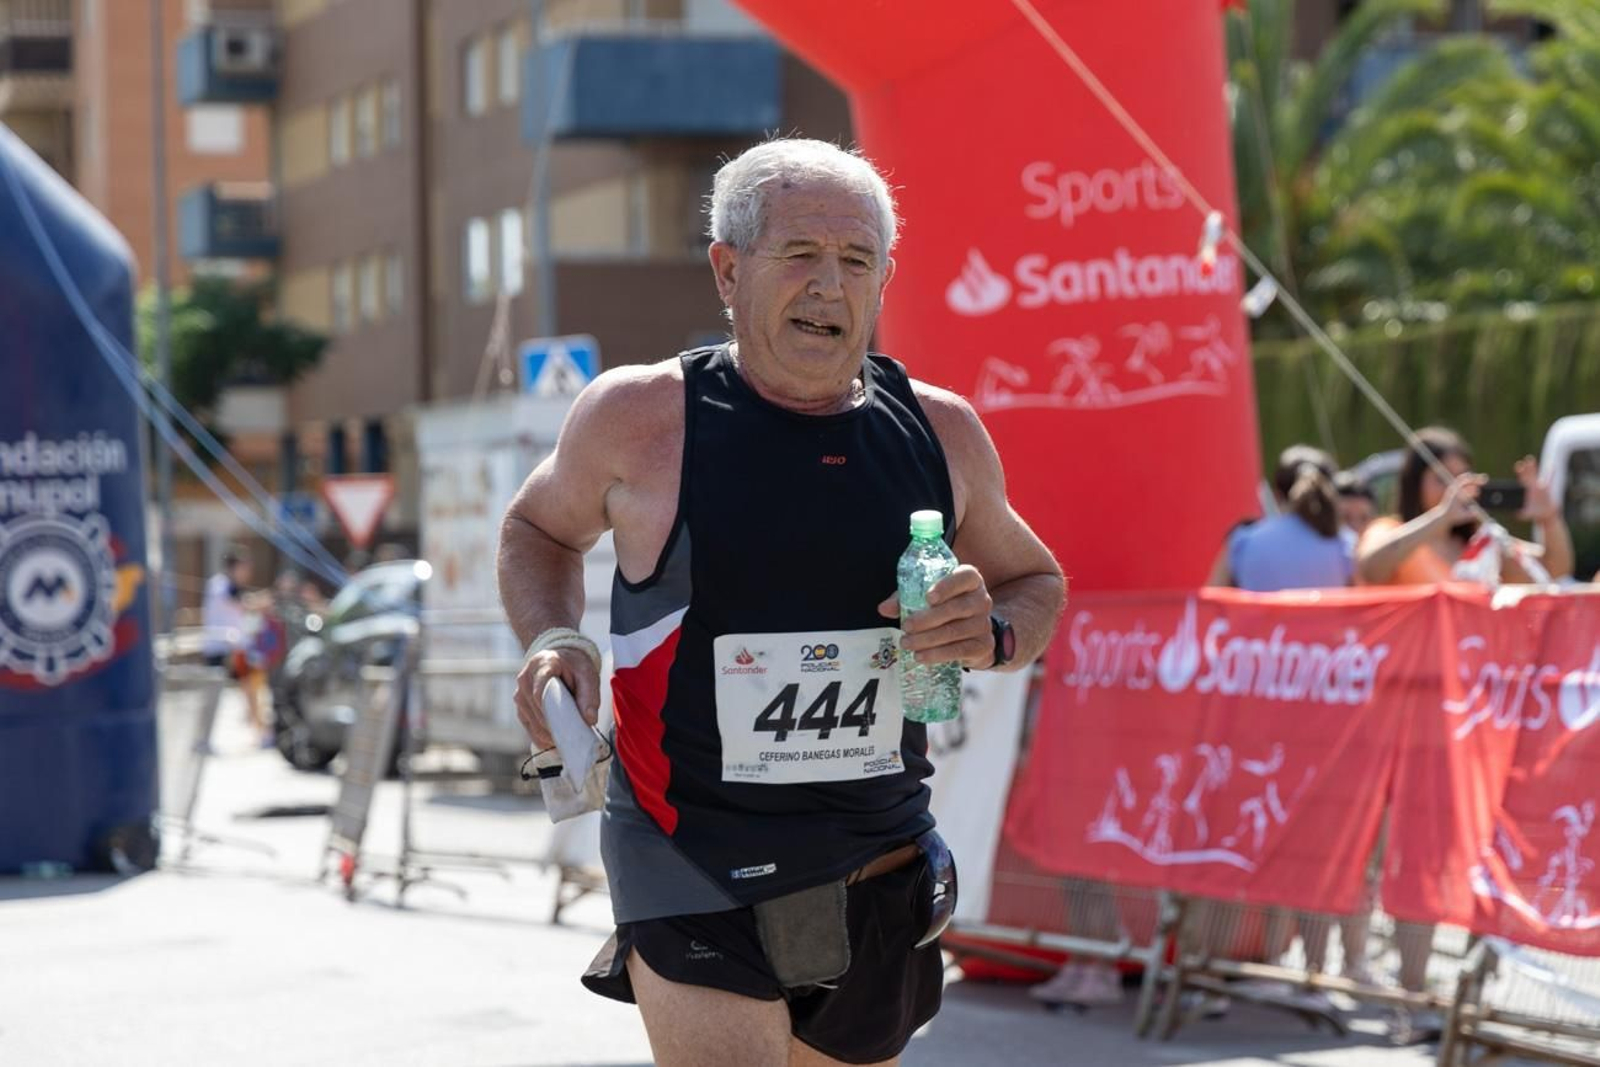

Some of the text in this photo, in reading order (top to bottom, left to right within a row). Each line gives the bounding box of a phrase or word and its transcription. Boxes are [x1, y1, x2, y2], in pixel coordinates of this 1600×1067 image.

[1020, 161, 1187, 229] Sports
[721, 666, 767, 675] Santander
[801, 643, 839, 661] 200
[1063, 610, 1388, 704] Sports Santander
[753, 679, 880, 742] 444
[759, 751, 800, 762] CEFERINO
[802, 748, 841, 761] BANEGAS
